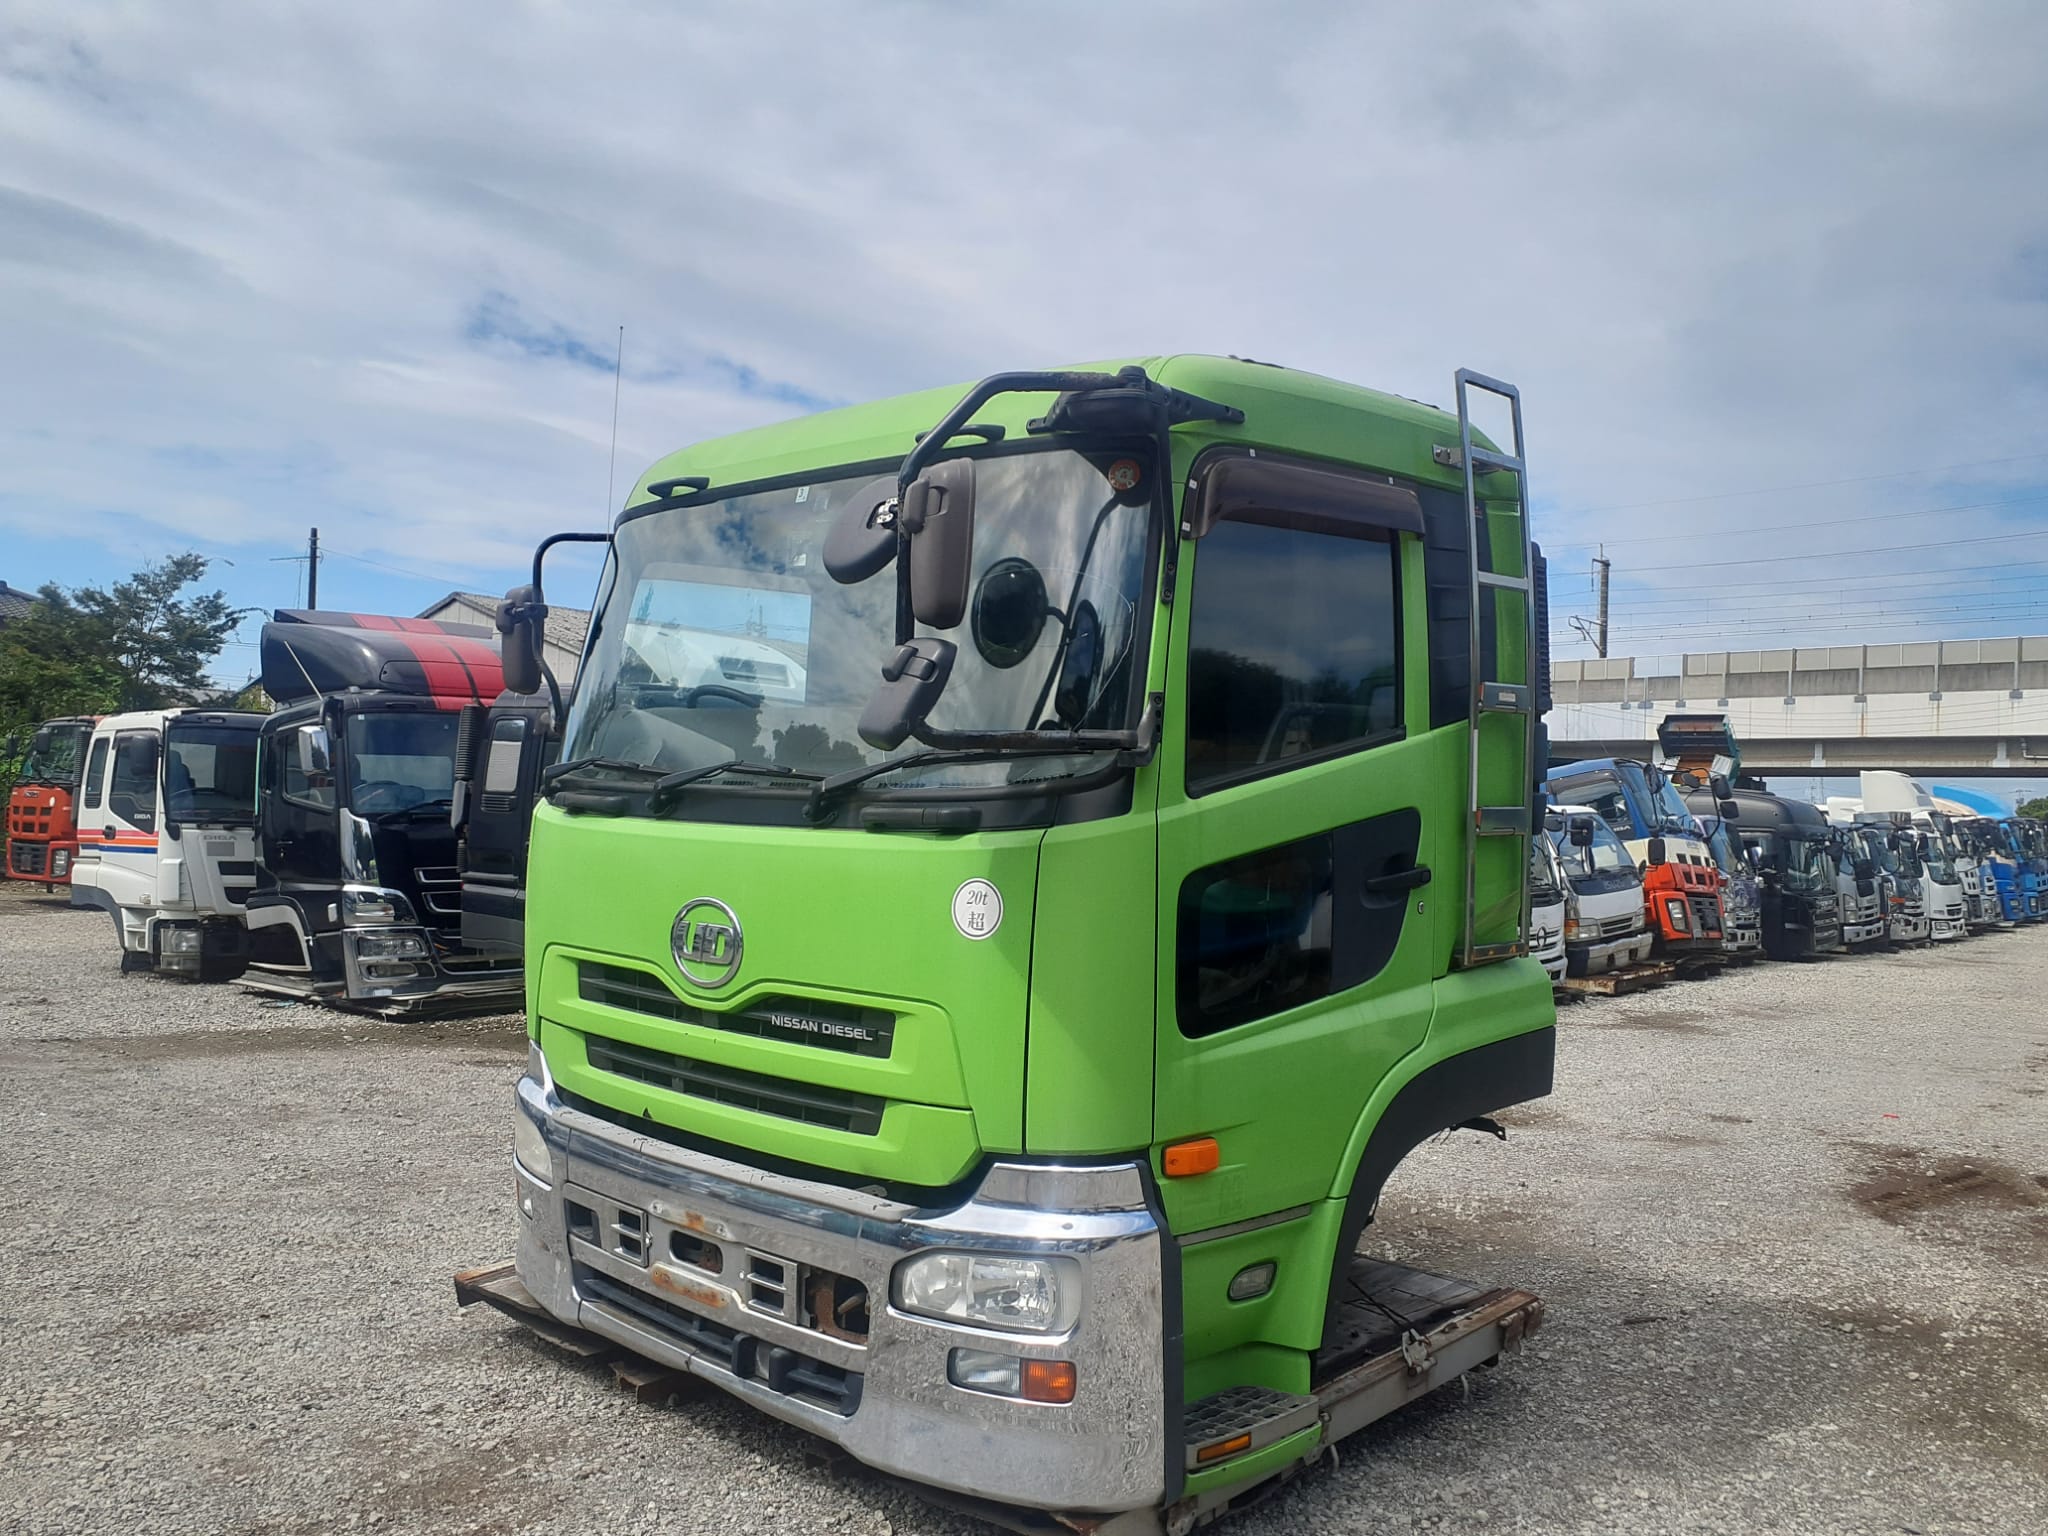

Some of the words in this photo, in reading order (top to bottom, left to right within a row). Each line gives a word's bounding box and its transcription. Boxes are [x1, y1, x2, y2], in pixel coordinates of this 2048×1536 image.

[966, 890, 989, 906] 20t
[967, 911, 985, 931] 超
[674, 920, 734, 965] UD
[771, 1015, 818, 1033] NISSAN
[822, 1023, 873, 1041] DIESEL
